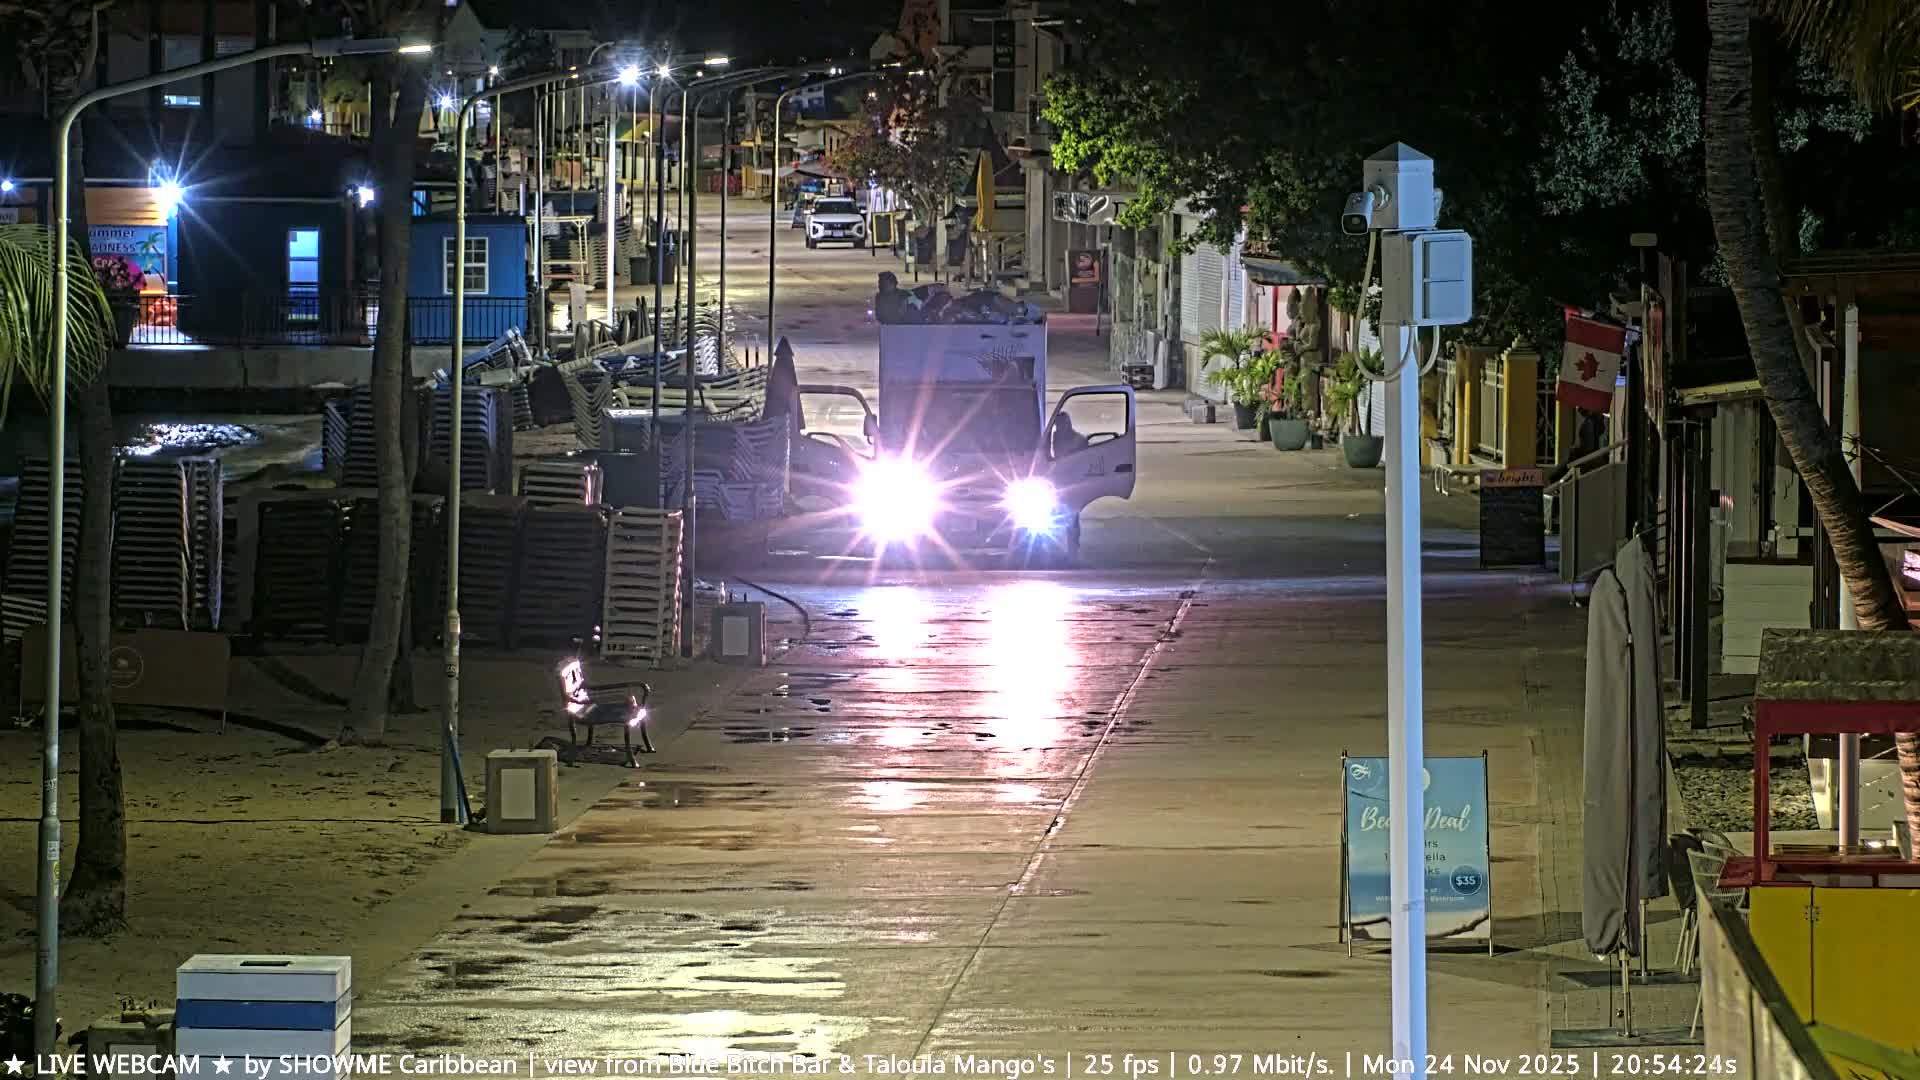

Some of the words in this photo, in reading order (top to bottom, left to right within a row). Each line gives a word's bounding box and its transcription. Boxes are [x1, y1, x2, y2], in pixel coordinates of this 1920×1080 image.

[89, 229, 135, 238] ummer
[91, 243, 136, 252] ADNESS
[1424, 804, 1471, 831] Deal
[1424, 839, 1439, 848] irs
[1425, 852, 1446, 861] ella
[1455, 875, 1477, 886] $35
